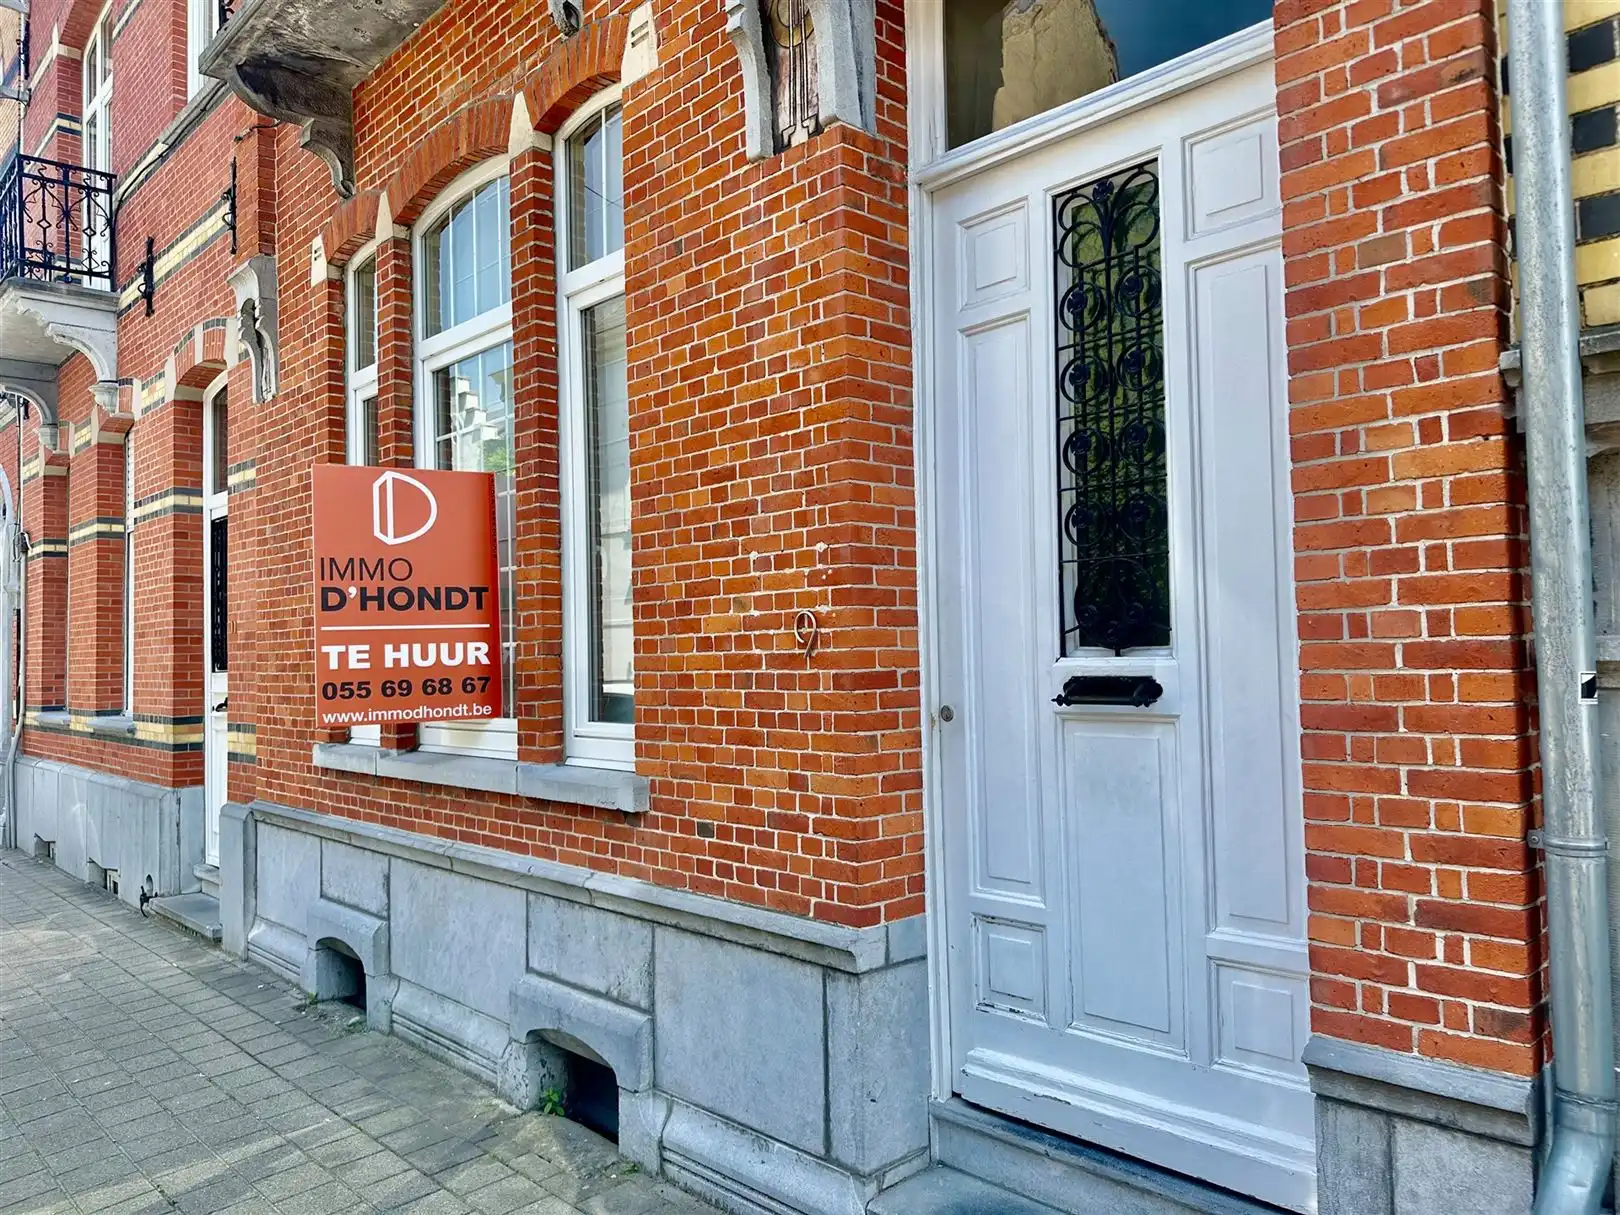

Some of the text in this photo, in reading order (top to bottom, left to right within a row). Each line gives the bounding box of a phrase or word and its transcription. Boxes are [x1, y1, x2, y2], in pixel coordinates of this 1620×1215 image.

[320, 557, 413, 582] IMMO
[321, 585, 489, 612] D'HONDT
[794, 610, 817, 656] 9
[321, 644, 371, 670] TE
[384, 641, 491, 668] HUUR
[322, 676, 491, 701] 055 69 68 67
[322, 703, 493, 724] www.immodhondt.be
